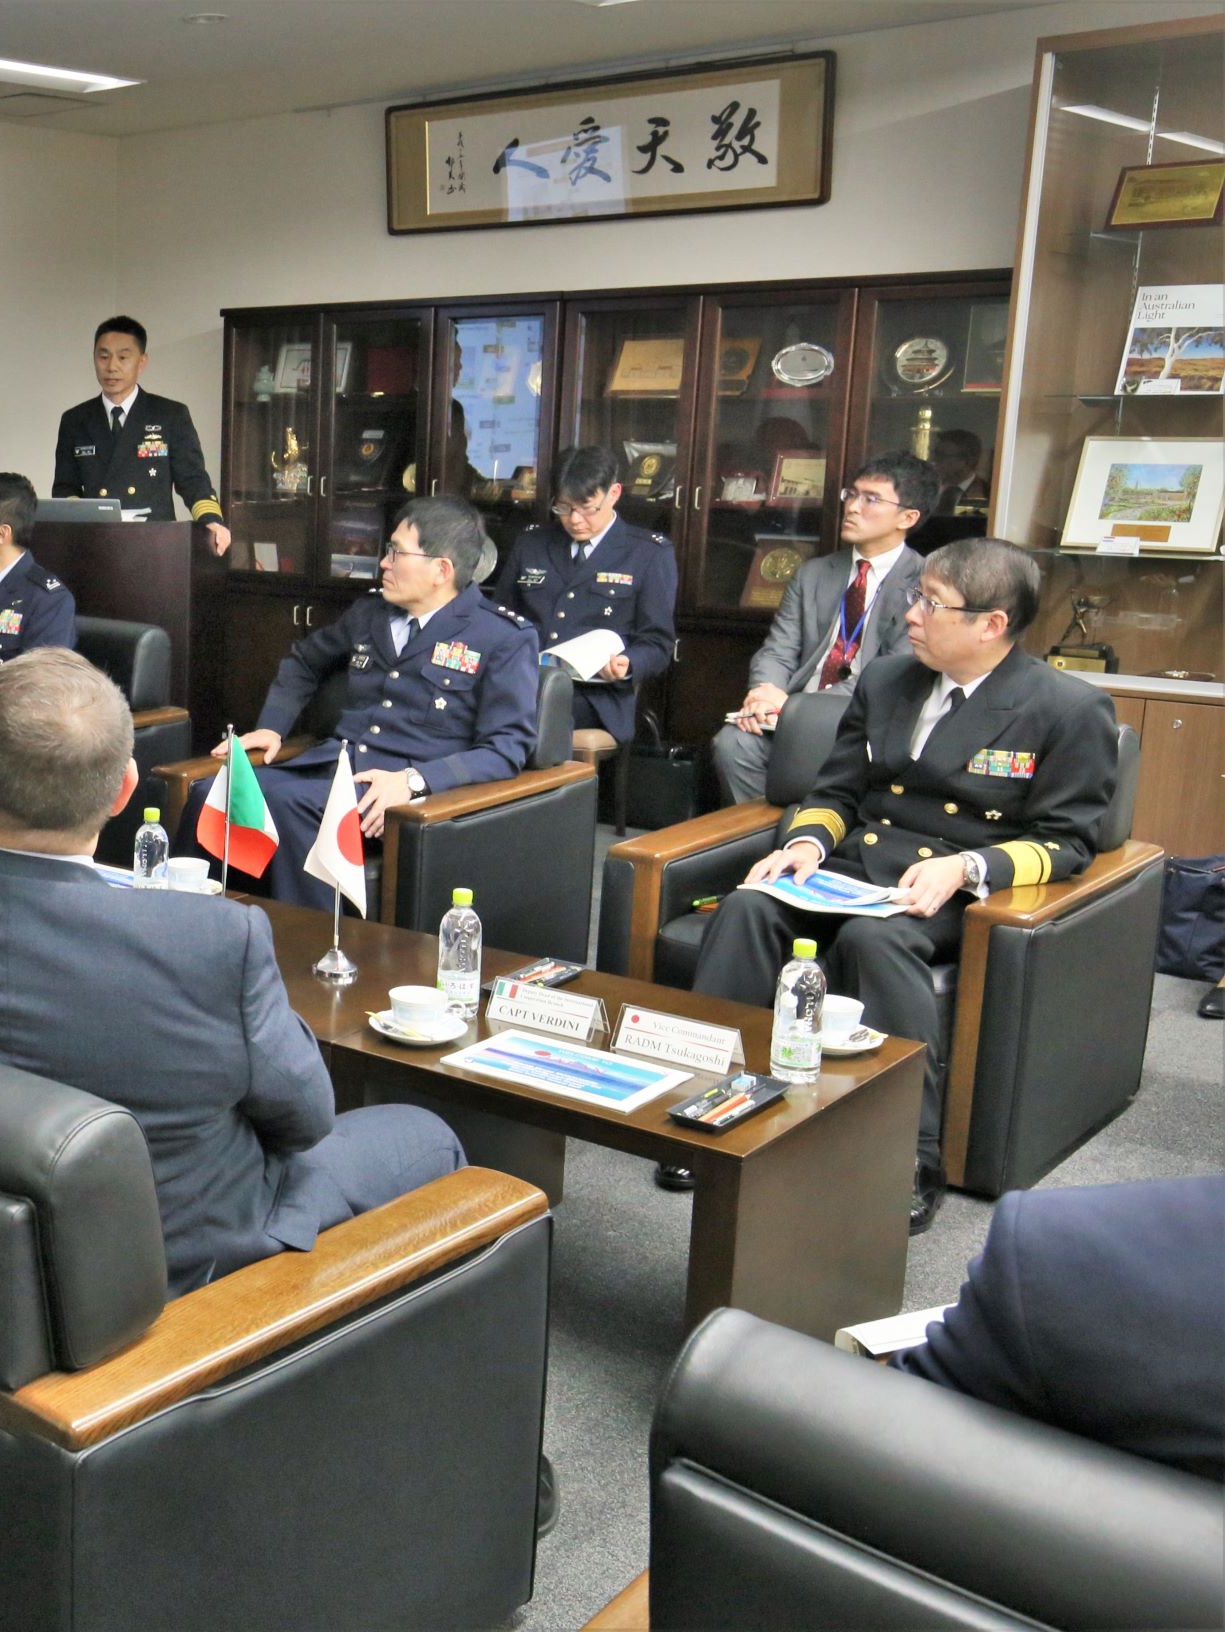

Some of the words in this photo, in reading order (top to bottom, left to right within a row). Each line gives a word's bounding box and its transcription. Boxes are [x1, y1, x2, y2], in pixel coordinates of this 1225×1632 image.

[1139, 300, 1196, 310] Australian
[1142, 292, 1152, 301] In
[1154, 293, 1168, 301] an
[1137, 310, 1166, 322] Light
[499, 1004, 528, 1019] CAPT
[530, 1011, 581, 1032] VERDINI
[652, 1021, 670, 1032] Vice
[671, 1026, 726, 1046] Commandant
[624, 1034, 662, 1051] RADM
[663, 1042, 726, 1067] Tsukagoshi
